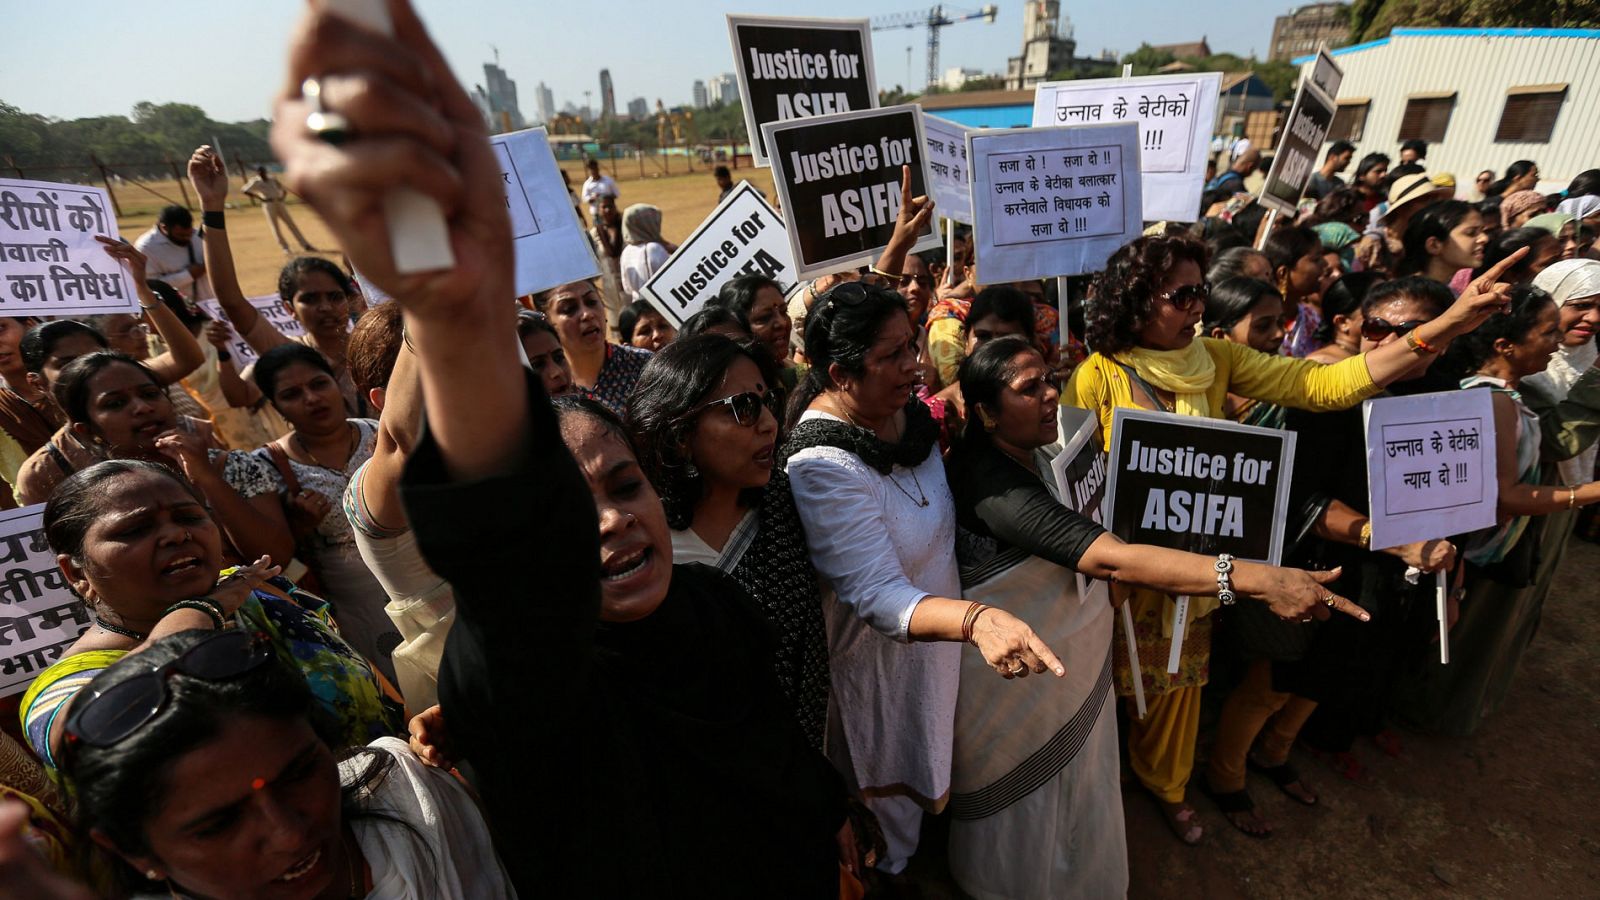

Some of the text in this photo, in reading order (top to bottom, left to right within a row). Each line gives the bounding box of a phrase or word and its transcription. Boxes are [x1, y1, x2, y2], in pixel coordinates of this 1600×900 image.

[750, 47, 859, 80] Justice for
[1057, 94, 1189, 122] उन्नाव के बेटीको
[926, 138, 944, 154] न्नाव
[1145, 129, 1163, 150] !!!
[791, 136, 913, 185] Justice for
[998, 160, 1019, 173] सजा
[1025, 155, 1036, 171] दो
[1063, 156, 1083, 168] सजा
[1088, 150, 1098, 166] दो
[995, 181, 1024, 194] उन्नाव
[1030, 176, 1040, 192] के
[64, 195, 104, 233] को
[1004, 197, 1048, 216] करनेवाले
[1098, 191, 1111, 207] को
[1031, 217, 1087, 236] सजा दो !!!
[670, 238, 739, 309] Justice
[731, 211, 766, 246] for
[6, 275, 48, 302] का
[50, 263, 122, 301] निषेध
[1386, 427, 1479, 458] उन्नाव के बेटीको
[1127, 440, 1272, 485] Justice for
[1404, 462, 1468, 489] न्याय दो !!!
[1074, 451, 1107, 513] Justic
[1141, 487, 1244, 538] ASIFA
